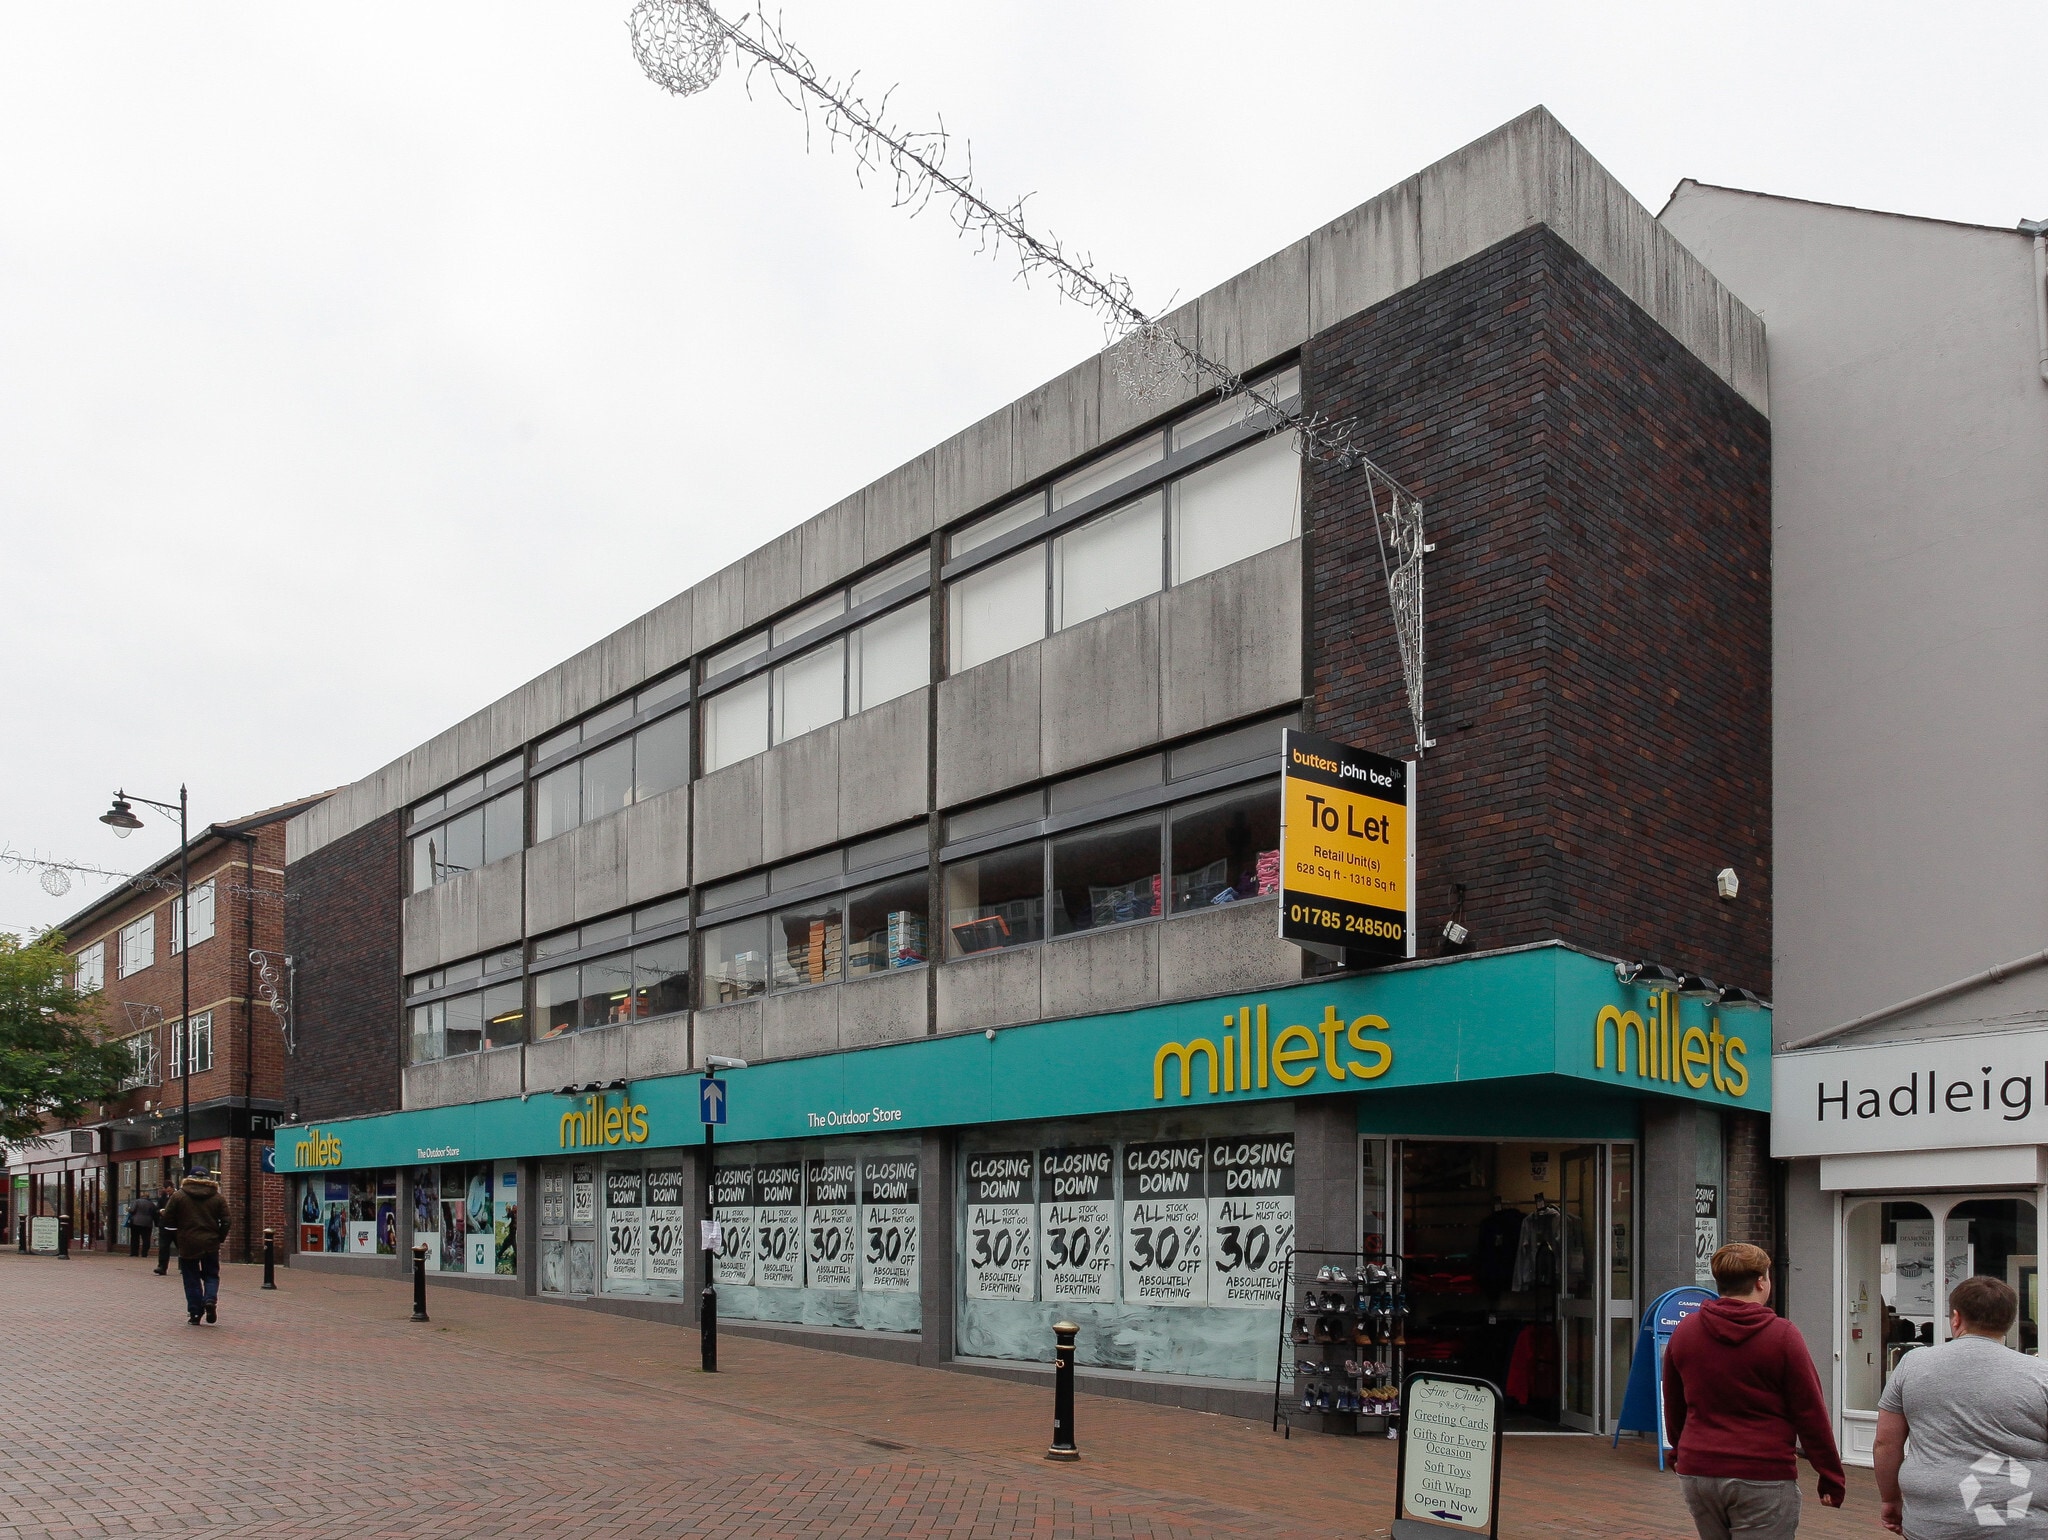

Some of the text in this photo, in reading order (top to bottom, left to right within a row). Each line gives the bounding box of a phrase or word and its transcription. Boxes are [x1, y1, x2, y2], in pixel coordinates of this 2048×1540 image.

[1293, 749, 1392, 787] butters john bee
[1390, 768, 1401, 779] bjb
[1306, 794, 1389, 844] To Let
[1314, 845, 1380, 873] Retail Unit(s)
[1297, 862, 1315, 875] 628
[1318, 866, 1331, 880] Sq
[1334, 870, 1340, 880] ft
[1350, 874, 1372, 886] 1318
[1374, 878, 1387, 891] Sq
[1390, 881, 1396, 891] ft
[1291, 904, 1401, 940] 01785 248500
[1596, 988, 1749, 1096] millets
[1153, 1003, 1392, 1099] millets
[560, 1095, 648, 1148] millets
[808, 1107, 902, 1127] The Outdoor Store
[295, 1129, 342, 1167] millets
[417, 1145, 460, 1159] The Outdoor Store
[1213, 1142, 1295, 1166] CLOSING
[1044, 1152, 1111, 1175] CLOSING
[1128, 1148, 1203, 1171] CLOSING
[758, 1168, 800, 1184] CLOSING
[810, 1166, 855, 1182] CLOSING
[865, 1162, 917, 1180] CLOSING
[971, 1158, 1031, 1178] CLOSING
[608, 1175, 641, 1189] CLOSING
[648, 1172, 683, 1186] CLOSING
[1054, 1175, 1099, 1196] DOWN
[1139, 1172, 1189, 1193] DOWN
[1226, 1167, 1281, 1190] DOWN
[653, 1189, 677, 1202] DOWN
[718, 1187, 745, 1202] DOWN
[764, 1186, 792, 1202] DOWN
[817, 1184, 847, 1201] DOWN
[873, 1182, 908, 1199] DOWN
[980, 1180, 1020, 1198] DOWN
[1695, 1188, 1714, 1202] OSING
[576, 1193, 592, 1209] 30%
[613, 1191, 636, 1204] DOWN
[1255, 1201, 1280, 1210] STOCK
[650, 1209, 665, 1222] ALL
[1002, 1208, 1019, 1216] STOCK
[1049, 1206, 1077, 1225] ALL
[1078, 1205, 1098, 1214] STOCK
[1133, 1204, 1164, 1224] ALL
[1166, 1203, 1188, 1212] STOCK
[1219, 1201, 1254, 1223] ALL
[1255, 1211, 1292, 1220] MUST GO!
[1695, 1202, 1710, 1214] OWN
[611, 1211, 624, 1224] ALL
[715, 1210, 731, 1223] ALL
[761, 1210, 778, 1225] ALL
[813, 1209, 830, 1225] ALL
[870, 1208, 891, 1224] ALL
[975, 1207, 1001, 1226] ALL
[1016, 1217, 1028, 1225] GO!
[1078, 1214, 1108, 1223] MUST GO!
[1166, 1212, 1199, 1222] MUST GO!
[610, 1225, 641, 1256] 30%
[649, 1225, 682, 1256] 30%
[759, 1226, 799, 1261] 30%
[810, 1227, 855, 1263] 30%
[867, 1226, 917, 1264] 30%
[971, 1228, 1031, 1269] 30%
[1046, 1225, 1112, 1270] 30%
[1129, 1225, 1202, 1272] 30%
[1215, 1224, 1295, 1273] 30%
[1696, 1233, 1714, 1259] 0%
[631, 1248, 640, 1257] OFF
[672, 1248, 682, 1257] OFF
[740, 1251, 751, 1260] OFF
[786, 1253, 798, 1262] OFF
[840, 1253, 854, 1264] OFF
[901, 1255, 915, 1266] OFF
[763, 1264, 794, 1272] ABSOLUTELY
[816, 1266, 851, 1274] ABSOLUTELY
[873, 1267, 910, 1276] ABSOLUTELY
[1011, 1259, 1031, 1271] OFF
[1089, 1258, 1110, 1271] OFF
[1178, 1260, 1201, 1273] OFF
[1268, 1261, 1293, 1274] OFF
[764, 1273, 793, 1281] EVERYTHING
[818, 1275, 851, 1284] EVERYTHING
[874, 1277, 910, 1287] EVERYTHING
[978, 1272, 1022, 1283] ABSOLUTELY
[1054, 1273, 1101, 1284] ABSOLUTELY
[1138, 1276, 1192, 1286] ABSOLUTELY
[1226, 1277, 1283, 1288] ABSOLUTELY
[980, 1283, 1020, 1293] EVERYTHING
[1055, 1284, 1101, 1295] EVERYTHING
[1139, 1287, 1191, 1298] EVERYTHING
[1228, 1289, 1281, 1300] EVERYTHING
[1661, 1318, 1680, 1326] Cam
[1420, 1385, 1488, 1406] Fine Things
[1414, 1409, 1489, 1430] Greeting Cards
[1413, 1427, 1487, 1451] Gifts for Every
[1426, 1442, 1472, 1459] Occasion
[1425, 1460, 1471, 1478] Soft Toys
[1422, 1477, 1471, 1498] Gift Wrap
[1414, 1493, 1478, 1514] Open Now
